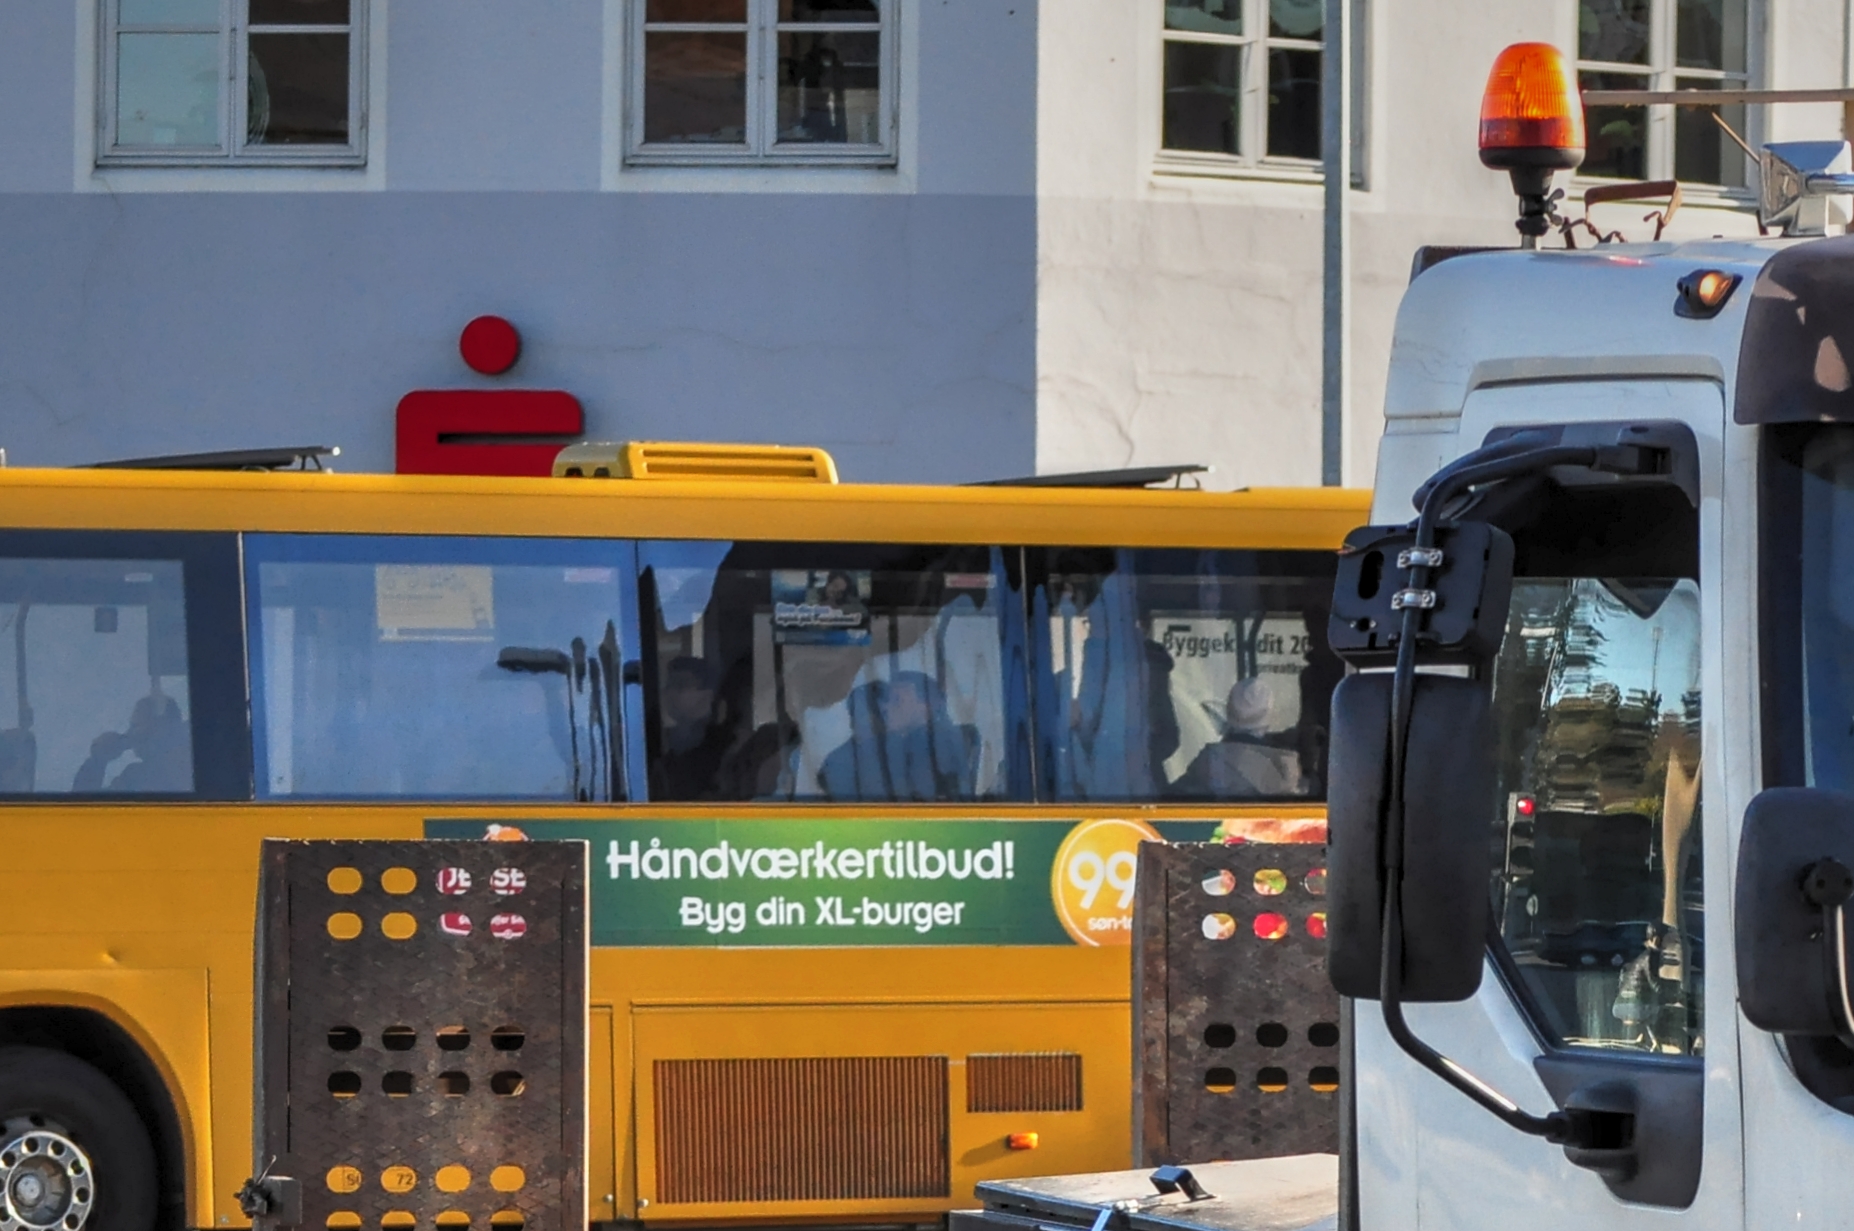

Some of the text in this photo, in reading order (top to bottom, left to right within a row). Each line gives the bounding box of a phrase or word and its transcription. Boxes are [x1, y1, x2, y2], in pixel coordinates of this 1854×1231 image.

[1163, 632, 1284, 658] Byggekdit
[606, 838, 1014, 880] Håndværkertilbud!
[680, 896, 965, 934] Byg din XL-burger
